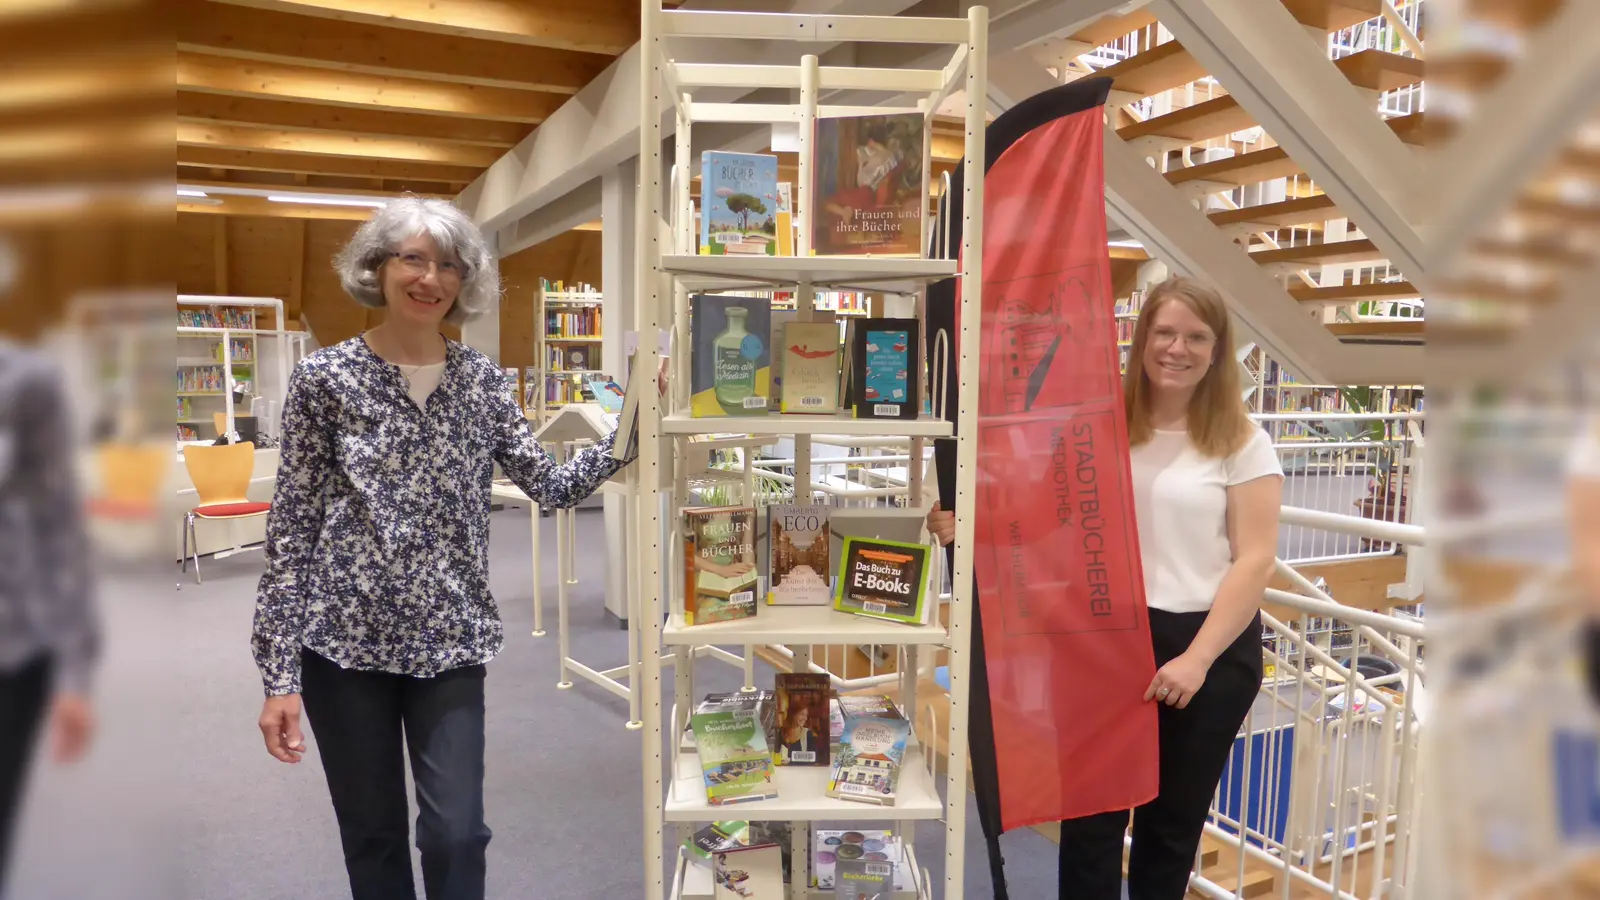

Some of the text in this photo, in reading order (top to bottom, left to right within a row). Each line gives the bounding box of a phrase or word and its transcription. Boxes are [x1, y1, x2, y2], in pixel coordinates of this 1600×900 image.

[855, 206, 920, 220] Frauen und
[836, 219, 901, 232] ihre Bücher
[716, 360, 754, 371] Lesen als
[716, 370, 750, 381] Medizin
[1051, 426, 1073, 529] MEDIOTHEK
[784, 507, 819, 515] UMBERTO
[784, 515, 819, 532] ECO
[1073, 422, 1113, 617] STADTBÜCHEREI
[702, 521, 751, 536] FRAUEN
[718, 536, 736, 544] UND
[702, 543, 753, 558] BÜCHER
[855, 561, 901, 576] Das Buch zu
[853, 572, 911, 595] E-Books
